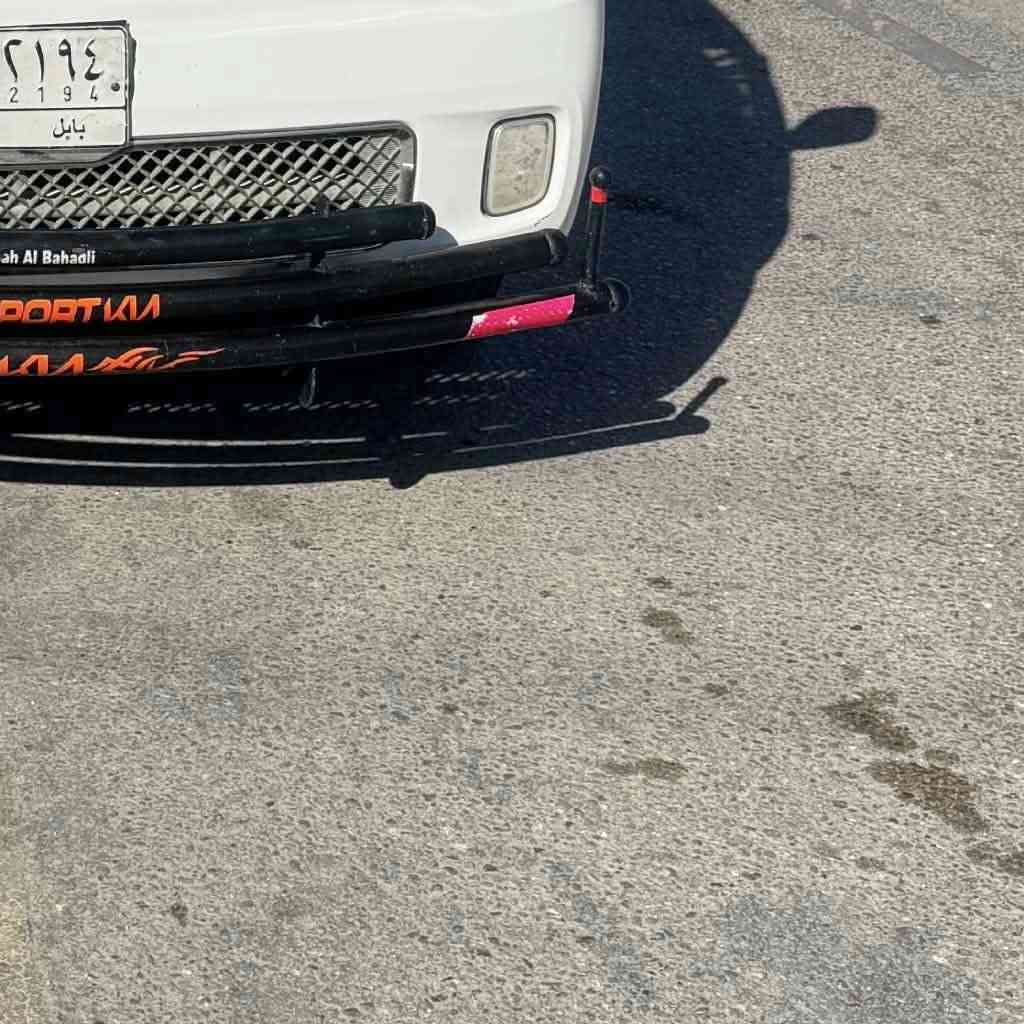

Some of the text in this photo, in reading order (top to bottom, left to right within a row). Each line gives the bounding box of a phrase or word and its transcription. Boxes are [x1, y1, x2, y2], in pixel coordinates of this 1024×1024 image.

[52, 118, 86, 140] بابل
[23, 249, 37, 264] Al
[42, 249, 96, 265] Bahadli
